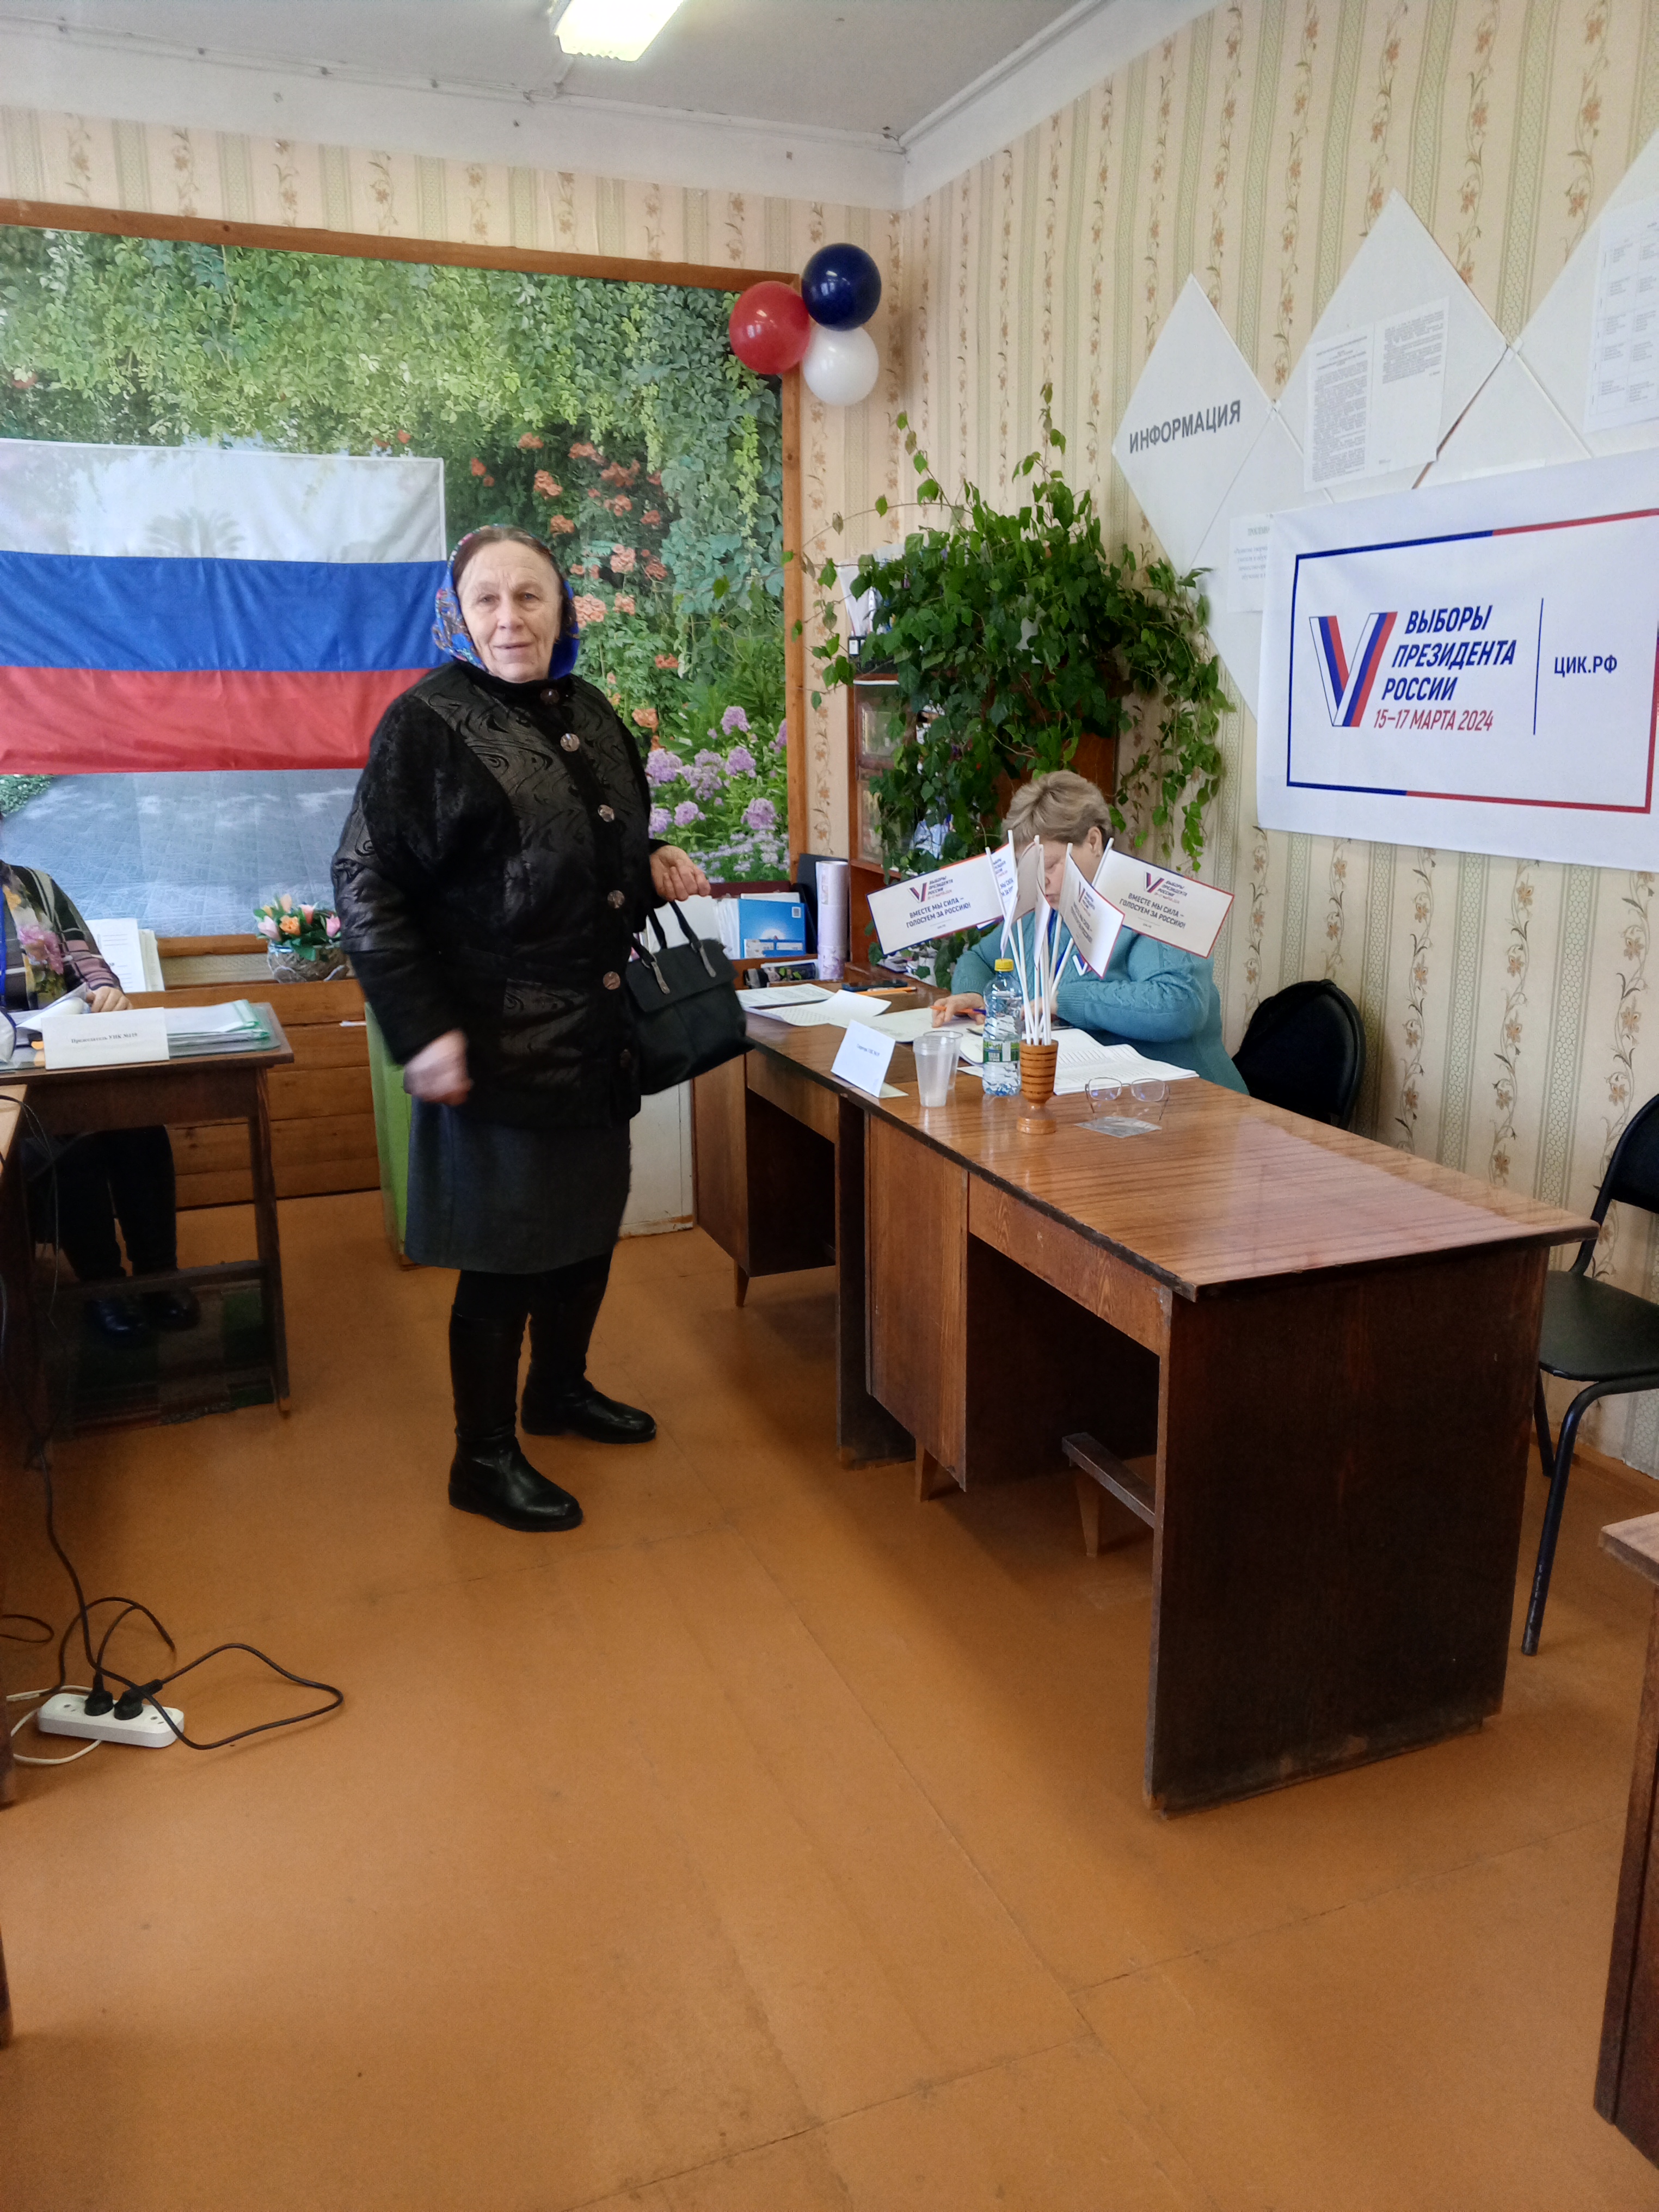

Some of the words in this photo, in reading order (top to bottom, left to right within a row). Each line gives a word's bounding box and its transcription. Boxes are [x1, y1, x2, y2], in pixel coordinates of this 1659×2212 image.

[1129, 400, 1241, 454] ИНФОРМАЦИЯ
[1404, 605, 1493, 634] ВЫБОРЫ
[1391, 640, 1517, 670] ПРЕЗИДЕНТА
[1554, 654, 1618, 678] ЦИК.РФ
[1381, 677, 1458, 701] РОССИИ
[1409, 710, 1457, 730] МАРТА
[1457, 710, 1494, 732] 2024
[906, 913, 936, 928] ГОЛОСУЕМ
[944, 902, 972, 916] РОССИЮ!
[909, 906, 931, 919] ВМЕСТЕ
[932, 902, 943, 912] МЫ
[943, 898, 960, 908] СИЛА
[1119, 898, 1150, 916] ГОЛОСУЕМ
[1150, 910, 1158, 919] ЗА
[1158, 913, 1186, 929] РОССИЮ!
[1128, 893, 1152, 907] ВМЕСТЕ
[1151, 901, 1163, 911] МЫ
[1163, 906, 1179, 918] СИЛА
